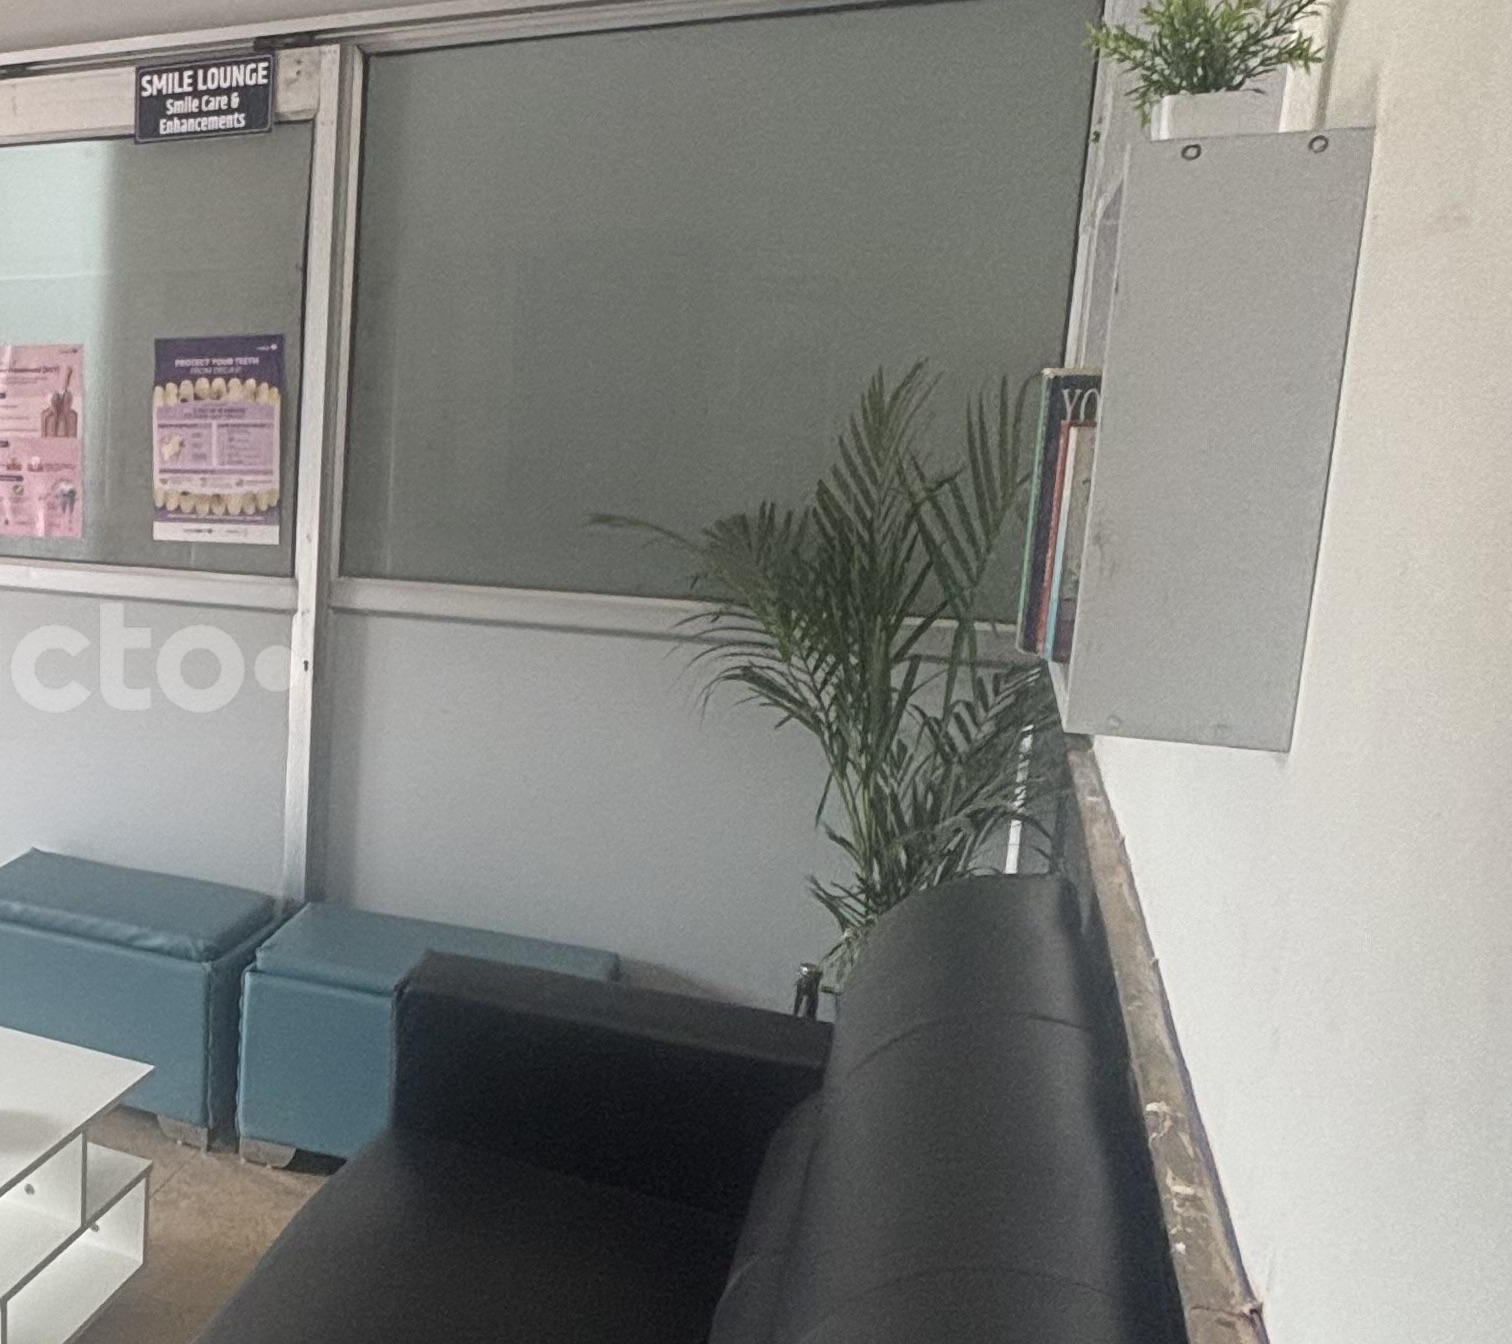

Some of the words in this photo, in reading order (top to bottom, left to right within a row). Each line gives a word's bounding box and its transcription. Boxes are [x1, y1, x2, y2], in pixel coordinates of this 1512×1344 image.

[141, 70, 194, 97] SMILE
[197, 62, 269, 91] LOUNGE
[166, 96, 199, 115] Smile
[201, 94, 229, 112] Care
[230, 92, 240, 109] &
[159, 112, 246, 135] Enhancements
